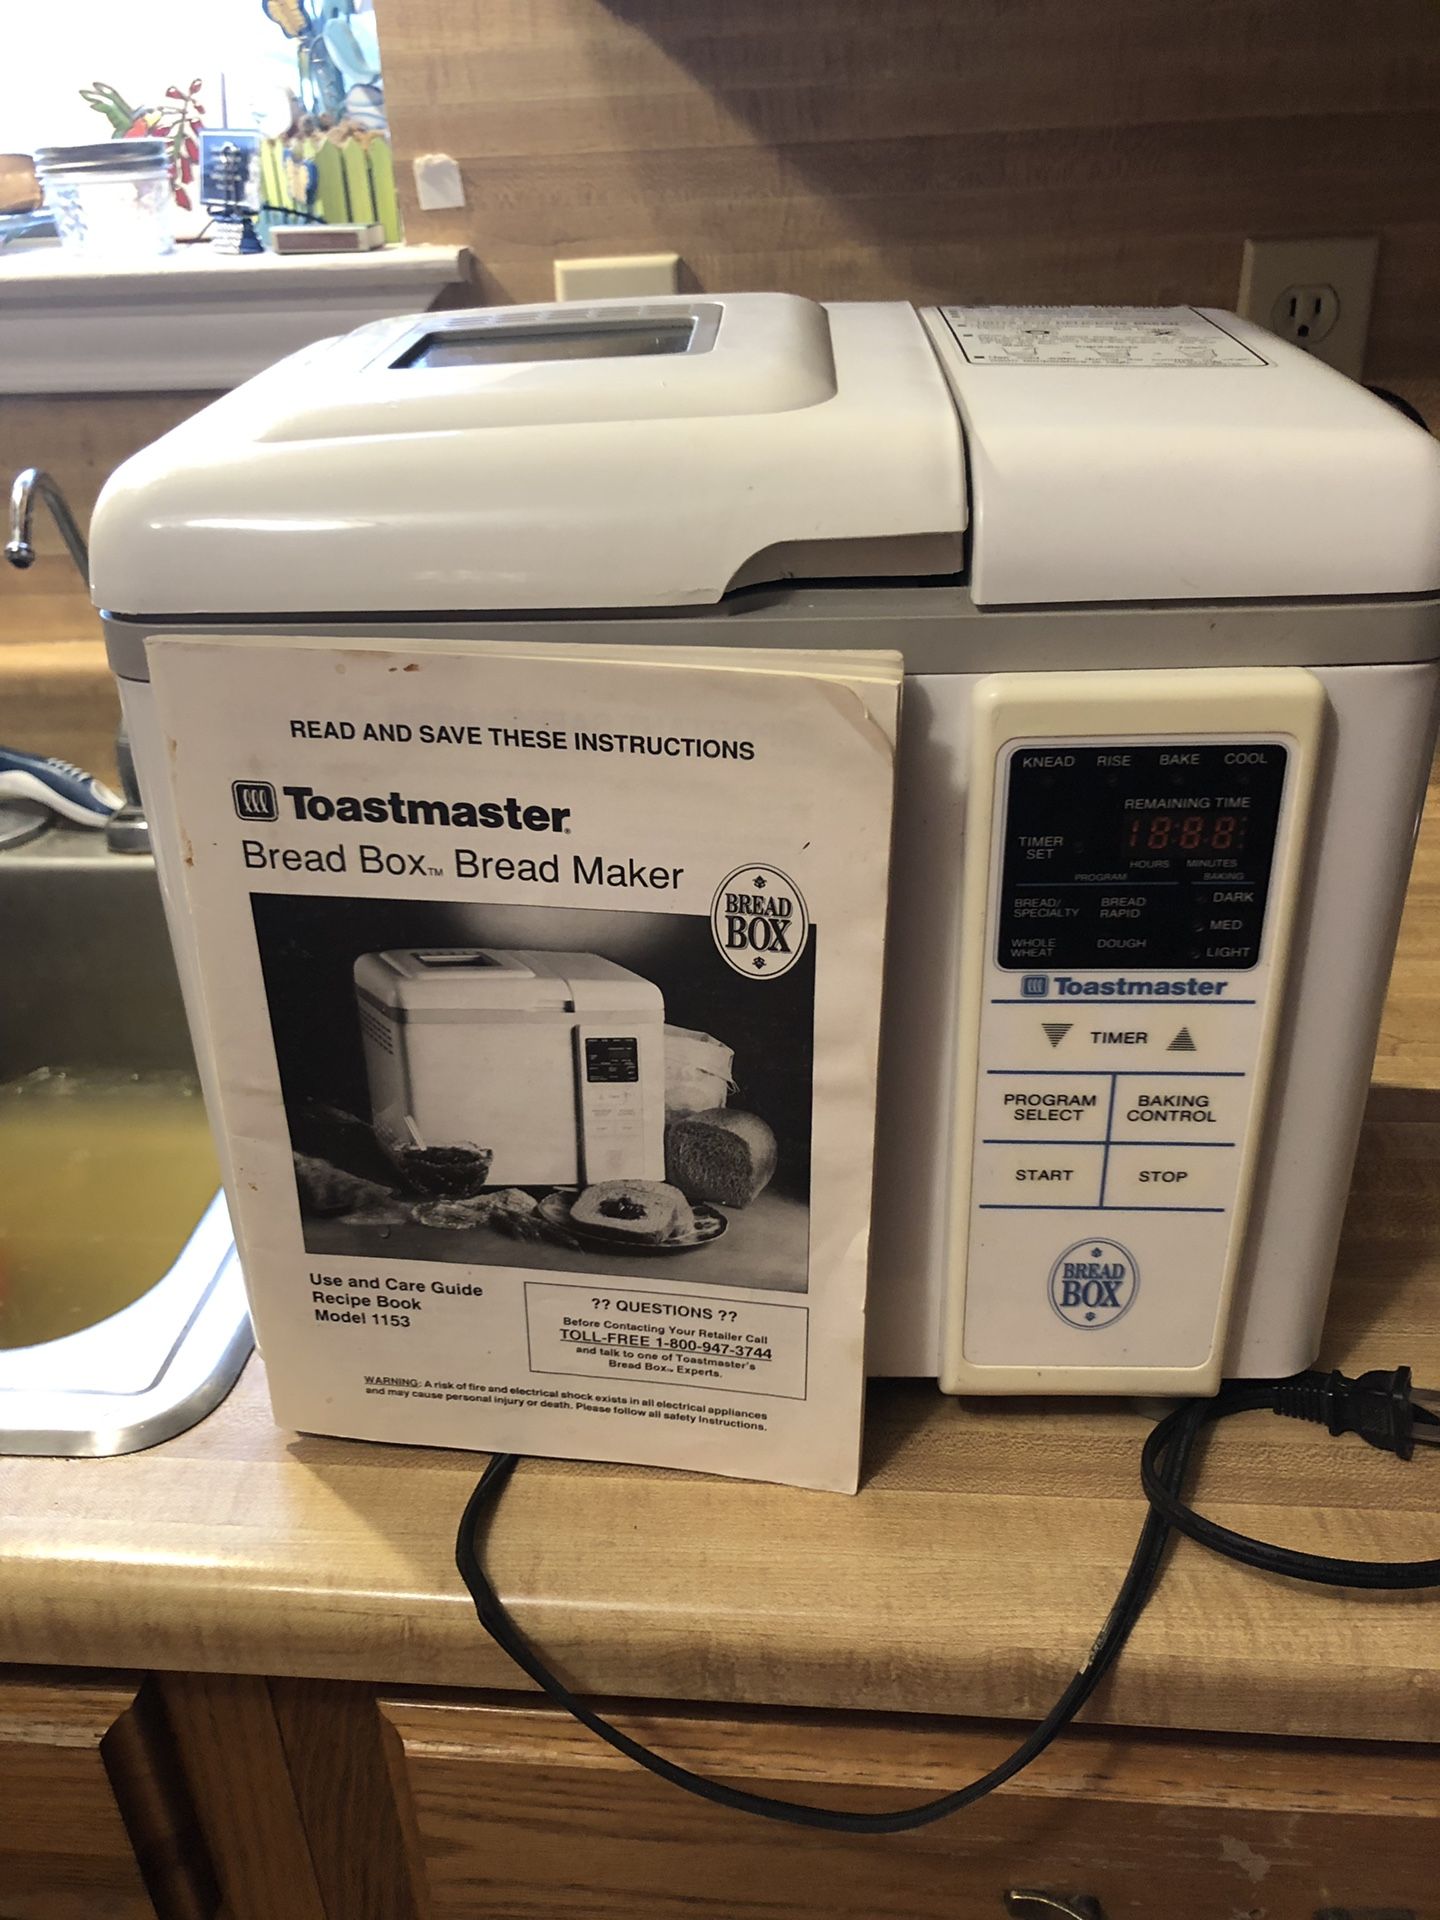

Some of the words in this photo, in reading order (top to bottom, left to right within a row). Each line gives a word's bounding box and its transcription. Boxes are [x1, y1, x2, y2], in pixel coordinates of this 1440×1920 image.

[290, 720, 355, 741] READ
[363, 724, 412, 743] AND
[419, 725, 482, 746] SAVE
[488, 727, 567, 750] THESE
[574, 732, 755, 761] INSTRUCTIONS
[1022, 756, 1076, 768] KNEAD
[1097, 755, 1131, 767] RISE
[1159, 754, 1200, 766] BAKE
[1224, 753, 1267, 765] COOL
[1125, 798, 1210, 810] REMAINING
[1215, 797, 1251, 809] TIME
[1018, 836, 1064, 847] TIMER
[1026, 849, 1054, 859] SET
[242, 840, 347, 873] Bread
[456, 848, 559, 883] Bread
[573, 856, 685, 890] Maker
[1130, 859, 1170, 868] HOURS
[1187, 859, 1238, 868] MINUTES
[1074, 873, 1128, 881] PROGRAM
[1203, 872, 1245, 881] BAKING
[1014, 898, 1061, 908] BREAD/
[1101, 897, 1147, 907] BREAD
[1213, 892, 1254, 902] DARK
[725, 893, 792, 918] BREAD
[1014, 908, 1080, 918] SPECIALTY
[1100, 908, 1141, 918] RAPID
[1210, 920, 1243, 930] MED
[725, 916, 792, 953] BOX
[1011, 938, 1057, 947] WHOLE
[1097, 938, 1147, 948] DOUGH
[1010, 948, 1054, 957] WHEAT
[1206, 947, 1250, 958] LIGHT
[1054, 977, 1228, 996] Toastmaster
[1090, 1031, 1149, 1045] TIMER
[1004, 1094, 1097, 1107] PROGRAM
[1138, 1095, 1209, 1108] BAKING
[1014, 1109, 1084, 1121] SELECT
[1126, 1110, 1217, 1123] CONTROL
[1015, 1169, 1073, 1181] START
[1138, 1170, 1188, 1183] STOP
[1063, 1263, 1125, 1280] BREAD
[310, 1273, 343, 1286] Use
[348, 1277, 380, 1289] and
[385, 1278, 426, 1292] Care
[431, 1281, 483, 1296] Guide
[312, 1291, 371, 1308] Recipe
[377, 1296, 422, 1310] Book
[1059, 1280, 1123, 1308] BOX
[616, 1300, 713, 1320] QUESTIONS
[315, 1309, 366, 1324] Model
[372, 1314, 411, 1327] 1153
[563, 1317, 600, 1328] Before
[603, 1320, 665, 1335] Contacting
[669, 1325, 696, 1337] Your
[698, 1328, 742, 1342] Retailer
[745, 1333, 768, 1344] Call
[560, 1328, 650, 1347] TOLL-FREE
[656, 1337, 772, 1359] 1-800-947-3744
[576, 1345, 597, 1355] and
[599, 1347, 620, 1357] talk
[623, 1350, 635, 1358] to
[637, 1352, 658, 1361] one
[661, 1352, 673, 1362] of
[676, 1354, 756, 1371] Toastmaster's
[608, 1359, 642, 1370] Bread
[676, 1365, 723, 1378] Experts.
[364, 1376, 422, 1388] WARNING:
[424, 1380, 433, 1388] A
[434, 1380, 454, 1390] risk
[456, 1382, 467, 1390] of
[468, 1382, 486, 1392] fire
[488, 1385, 508, 1394] and
[509, 1386, 558, 1398] electrical
[560, 1391, 593, 1401] shock
[595, 1395, 628, 1404] exists
[629, 1397, 640, 1405] in
[642, 1399, 655, 1407] all
[656, 1400, 706, 1412] electrical
[708, 1405, 767, 1420] appliances
[366, 1387, 385, 1395] and
[387, 1388, 410, 1398] may
[412, 1390, 443, 1399] cause
[445, 1392, 492, 1404] personal
[494, 1396, 525, 1407] injury
[540, 1400, 574, 1410] death.
[576, 1402, 611, 1413] Please
[613, 1406, 646, 1417] follow
[648, 1410, 661, 1418] all
[663, 1411, 696, 1424] safety
